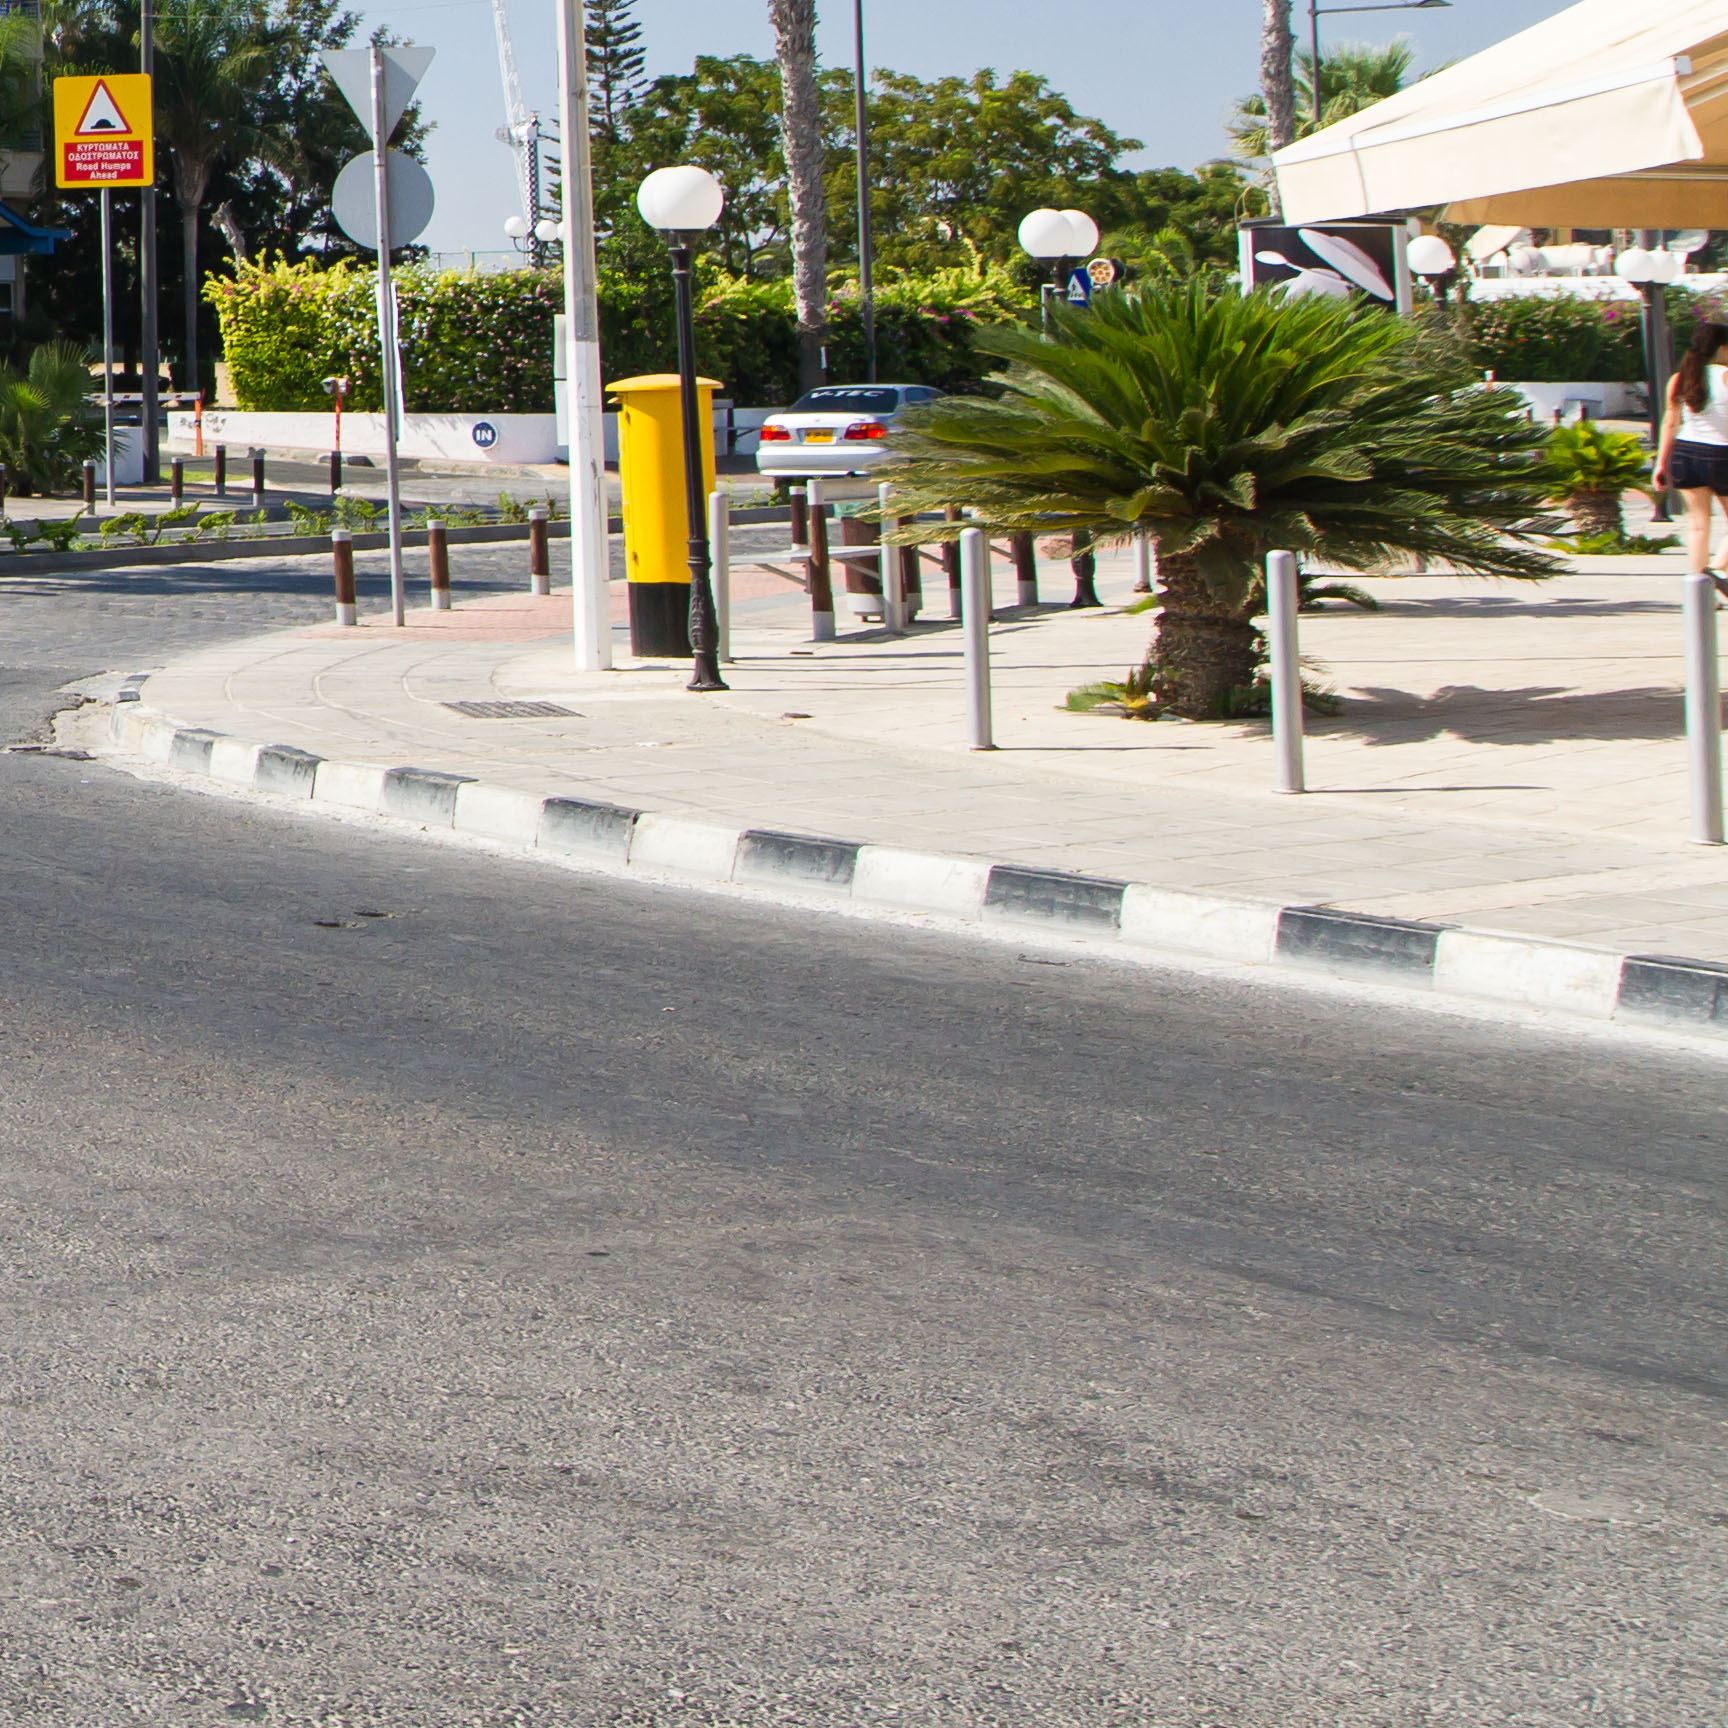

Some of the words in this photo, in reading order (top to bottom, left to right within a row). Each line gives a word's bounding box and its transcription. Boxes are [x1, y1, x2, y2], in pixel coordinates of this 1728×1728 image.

[76, 141, 130, 152] ΚΥΡΤΩΜΑΤΑ
[76, 161, 99, 171] Road
[101, 161, 132, 172] Humps
[89, 170, 118, 180] Ahead
[475, 429, 493, 441] IN
